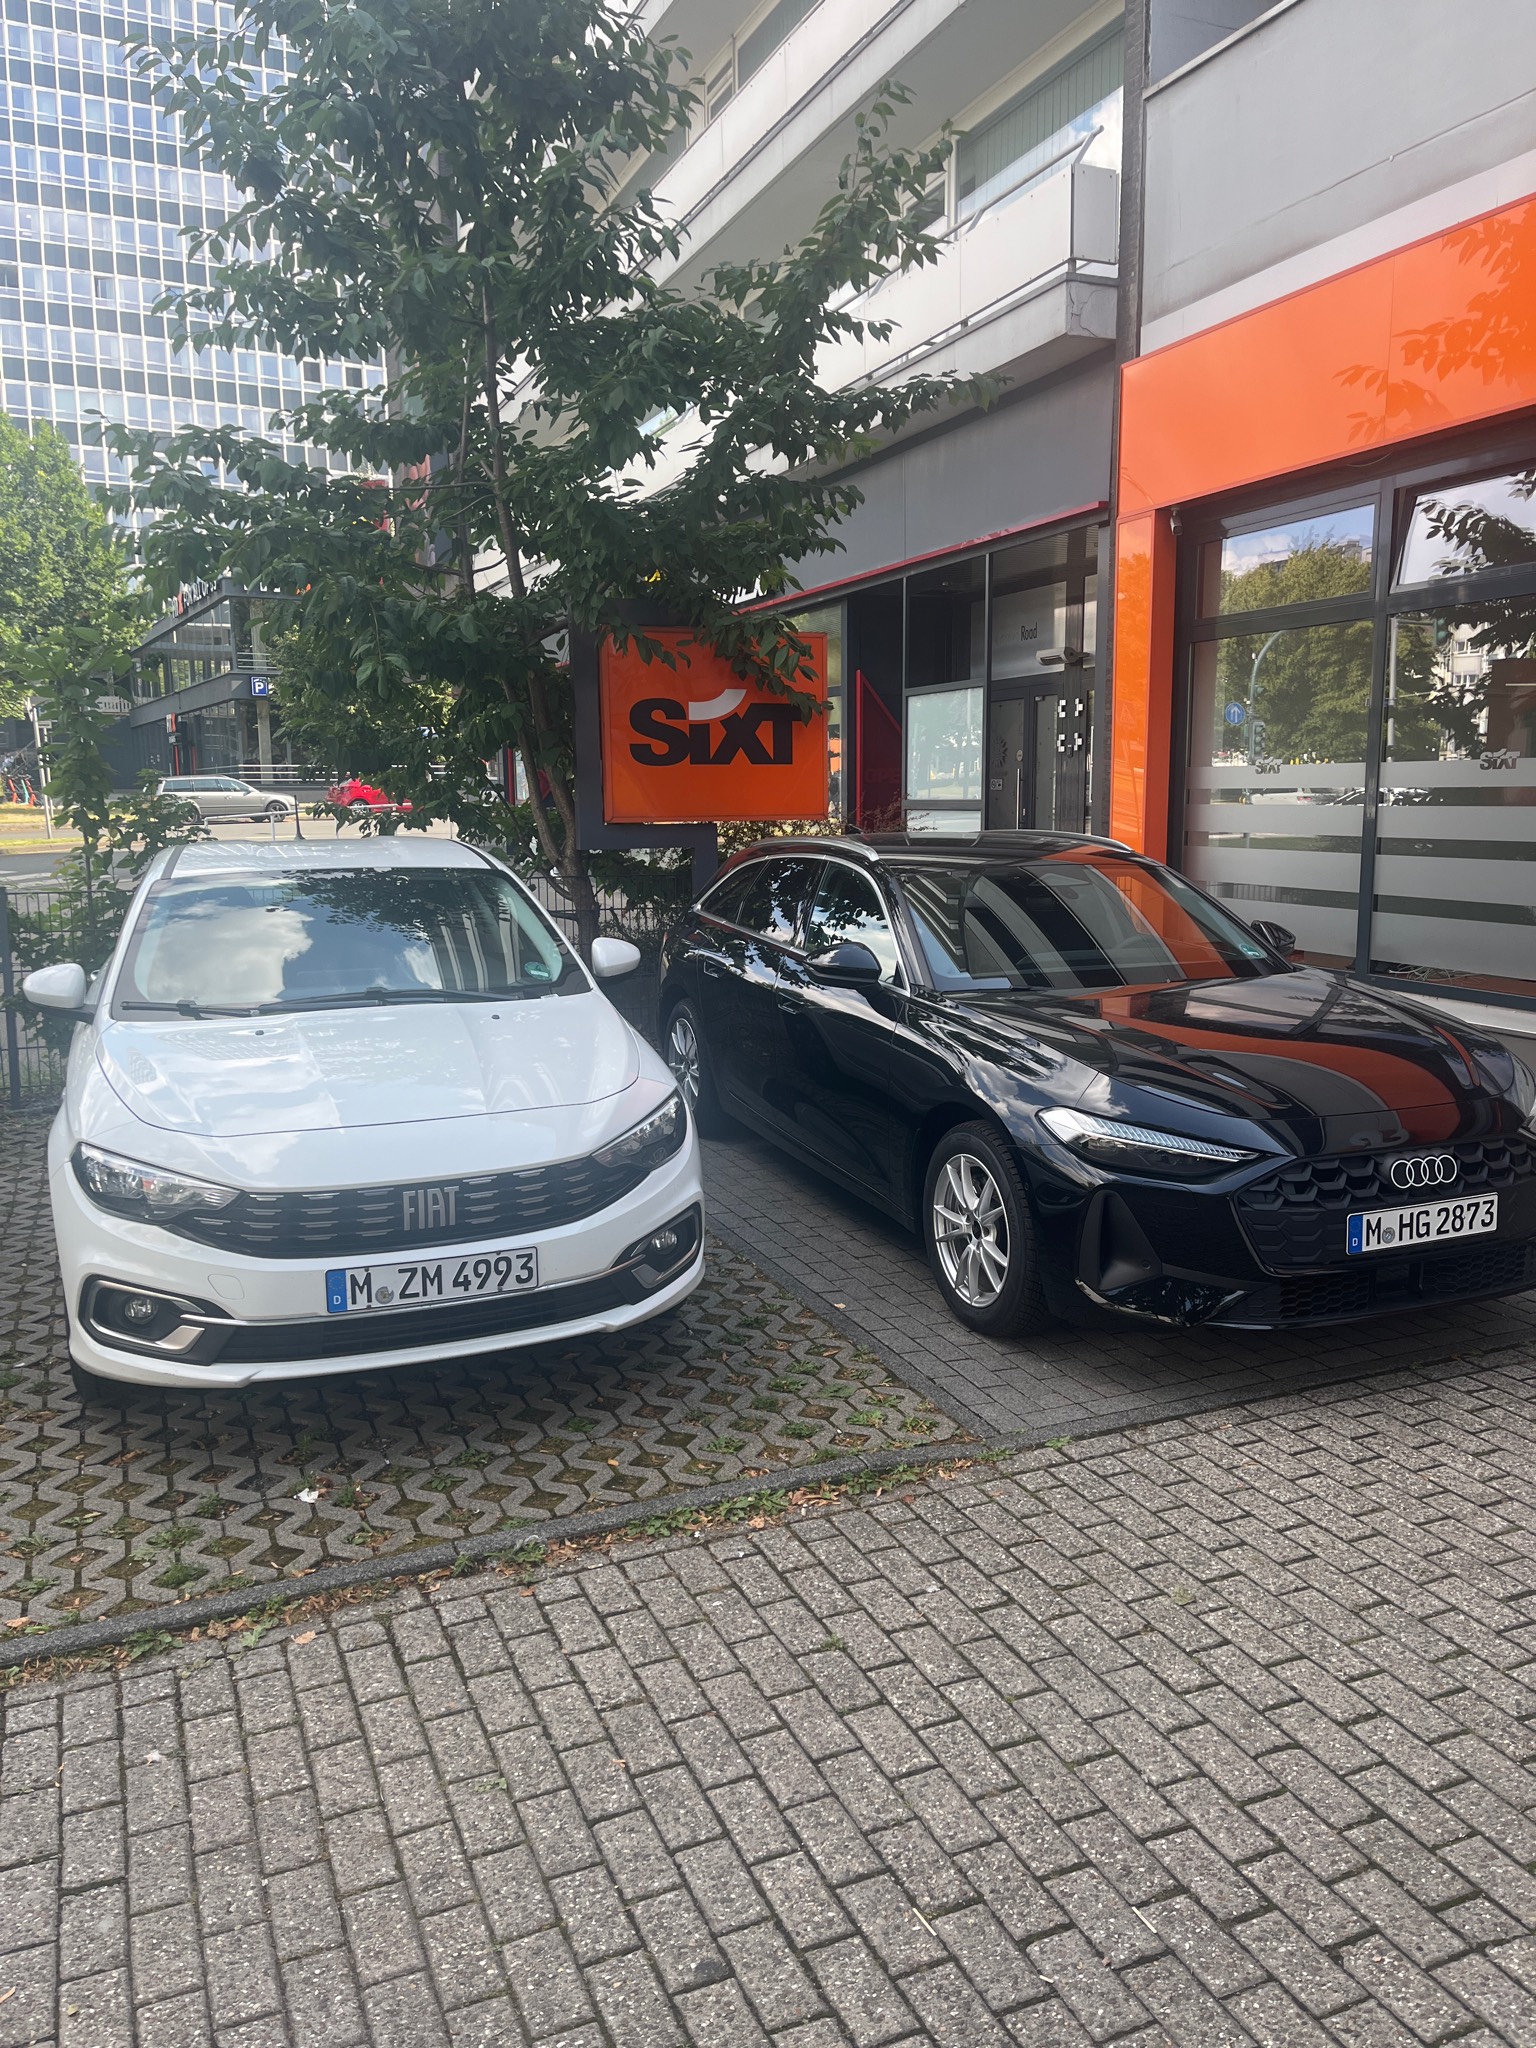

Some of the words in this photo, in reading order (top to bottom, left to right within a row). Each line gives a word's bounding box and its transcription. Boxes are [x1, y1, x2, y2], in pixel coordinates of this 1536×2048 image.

[1020, 621, 1038, 641] Road
[254, 682, 264, 693] P
[402, 1186, 460, 1231] FIAT
[1352, 1237, 1359, 1247] D
[1365, 1216, 1382, 1247] M
[1398, 1210, 1431, 1242] HG
[1436, 1199, 1495, 1236] 2873
[333, 1295, 342, 1305] D
[349, 1272, 373, 1305] M
[398, 1264, 443, 1299] ZM
[452, 1252, 534, 1292] 4993
